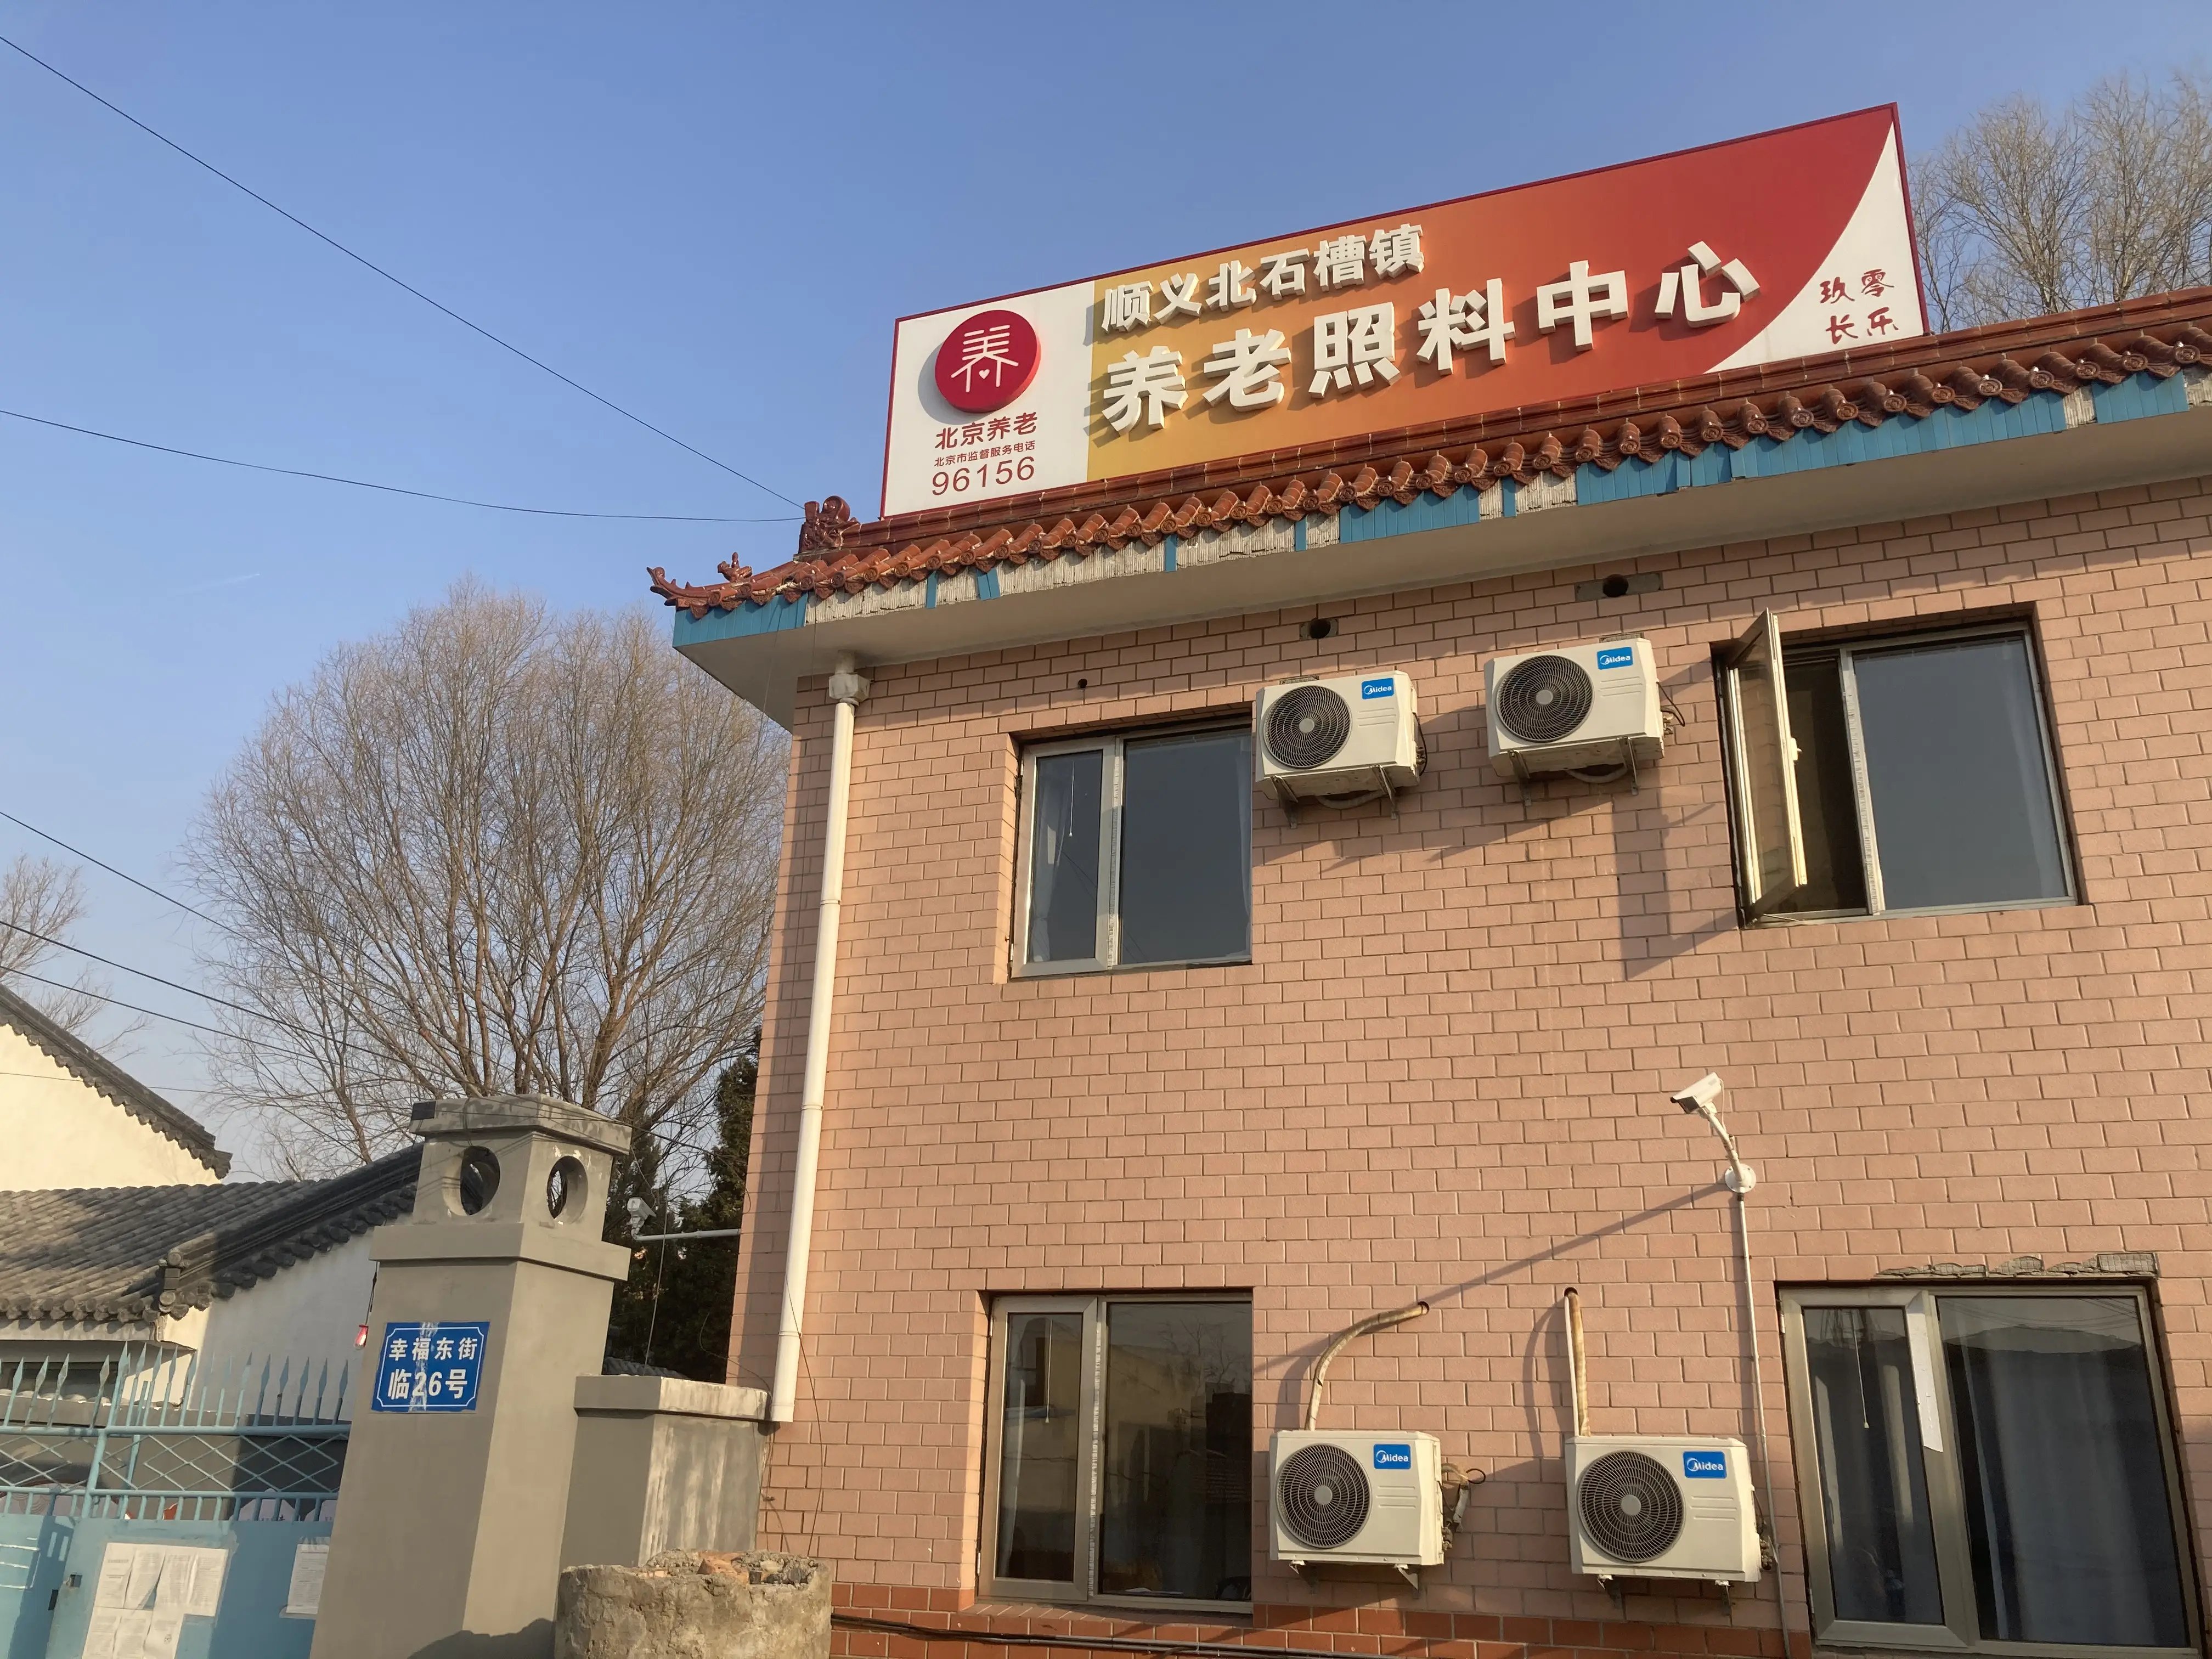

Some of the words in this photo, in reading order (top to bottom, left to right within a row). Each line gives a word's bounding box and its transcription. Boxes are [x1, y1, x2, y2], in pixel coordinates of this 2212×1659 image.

[1101, 223, 1425, 332] 顺义北石槽镇
[1819, 268, 1894, 304] 玖零
[1102, 241, 1761, 432] 养老照料中心
[1825, 307, 1899, 345] 长乐
[935, 411, 1038, 450] 北京养老
[934, 440, 1036, 467] 北京市监督服务电话
[932, 456, 1035, 495] 96156
[1600, 654, 1631, 665] Midea
[1364, 685, 1392, 695] Midea
[388, 1336, 478, 1361] 幸福东街
[388, 1369, 467, 1400] 临26号
[1375, 1450, 1409, 1463] Midea
[1686, 1457, 1724, 1472] Midea
